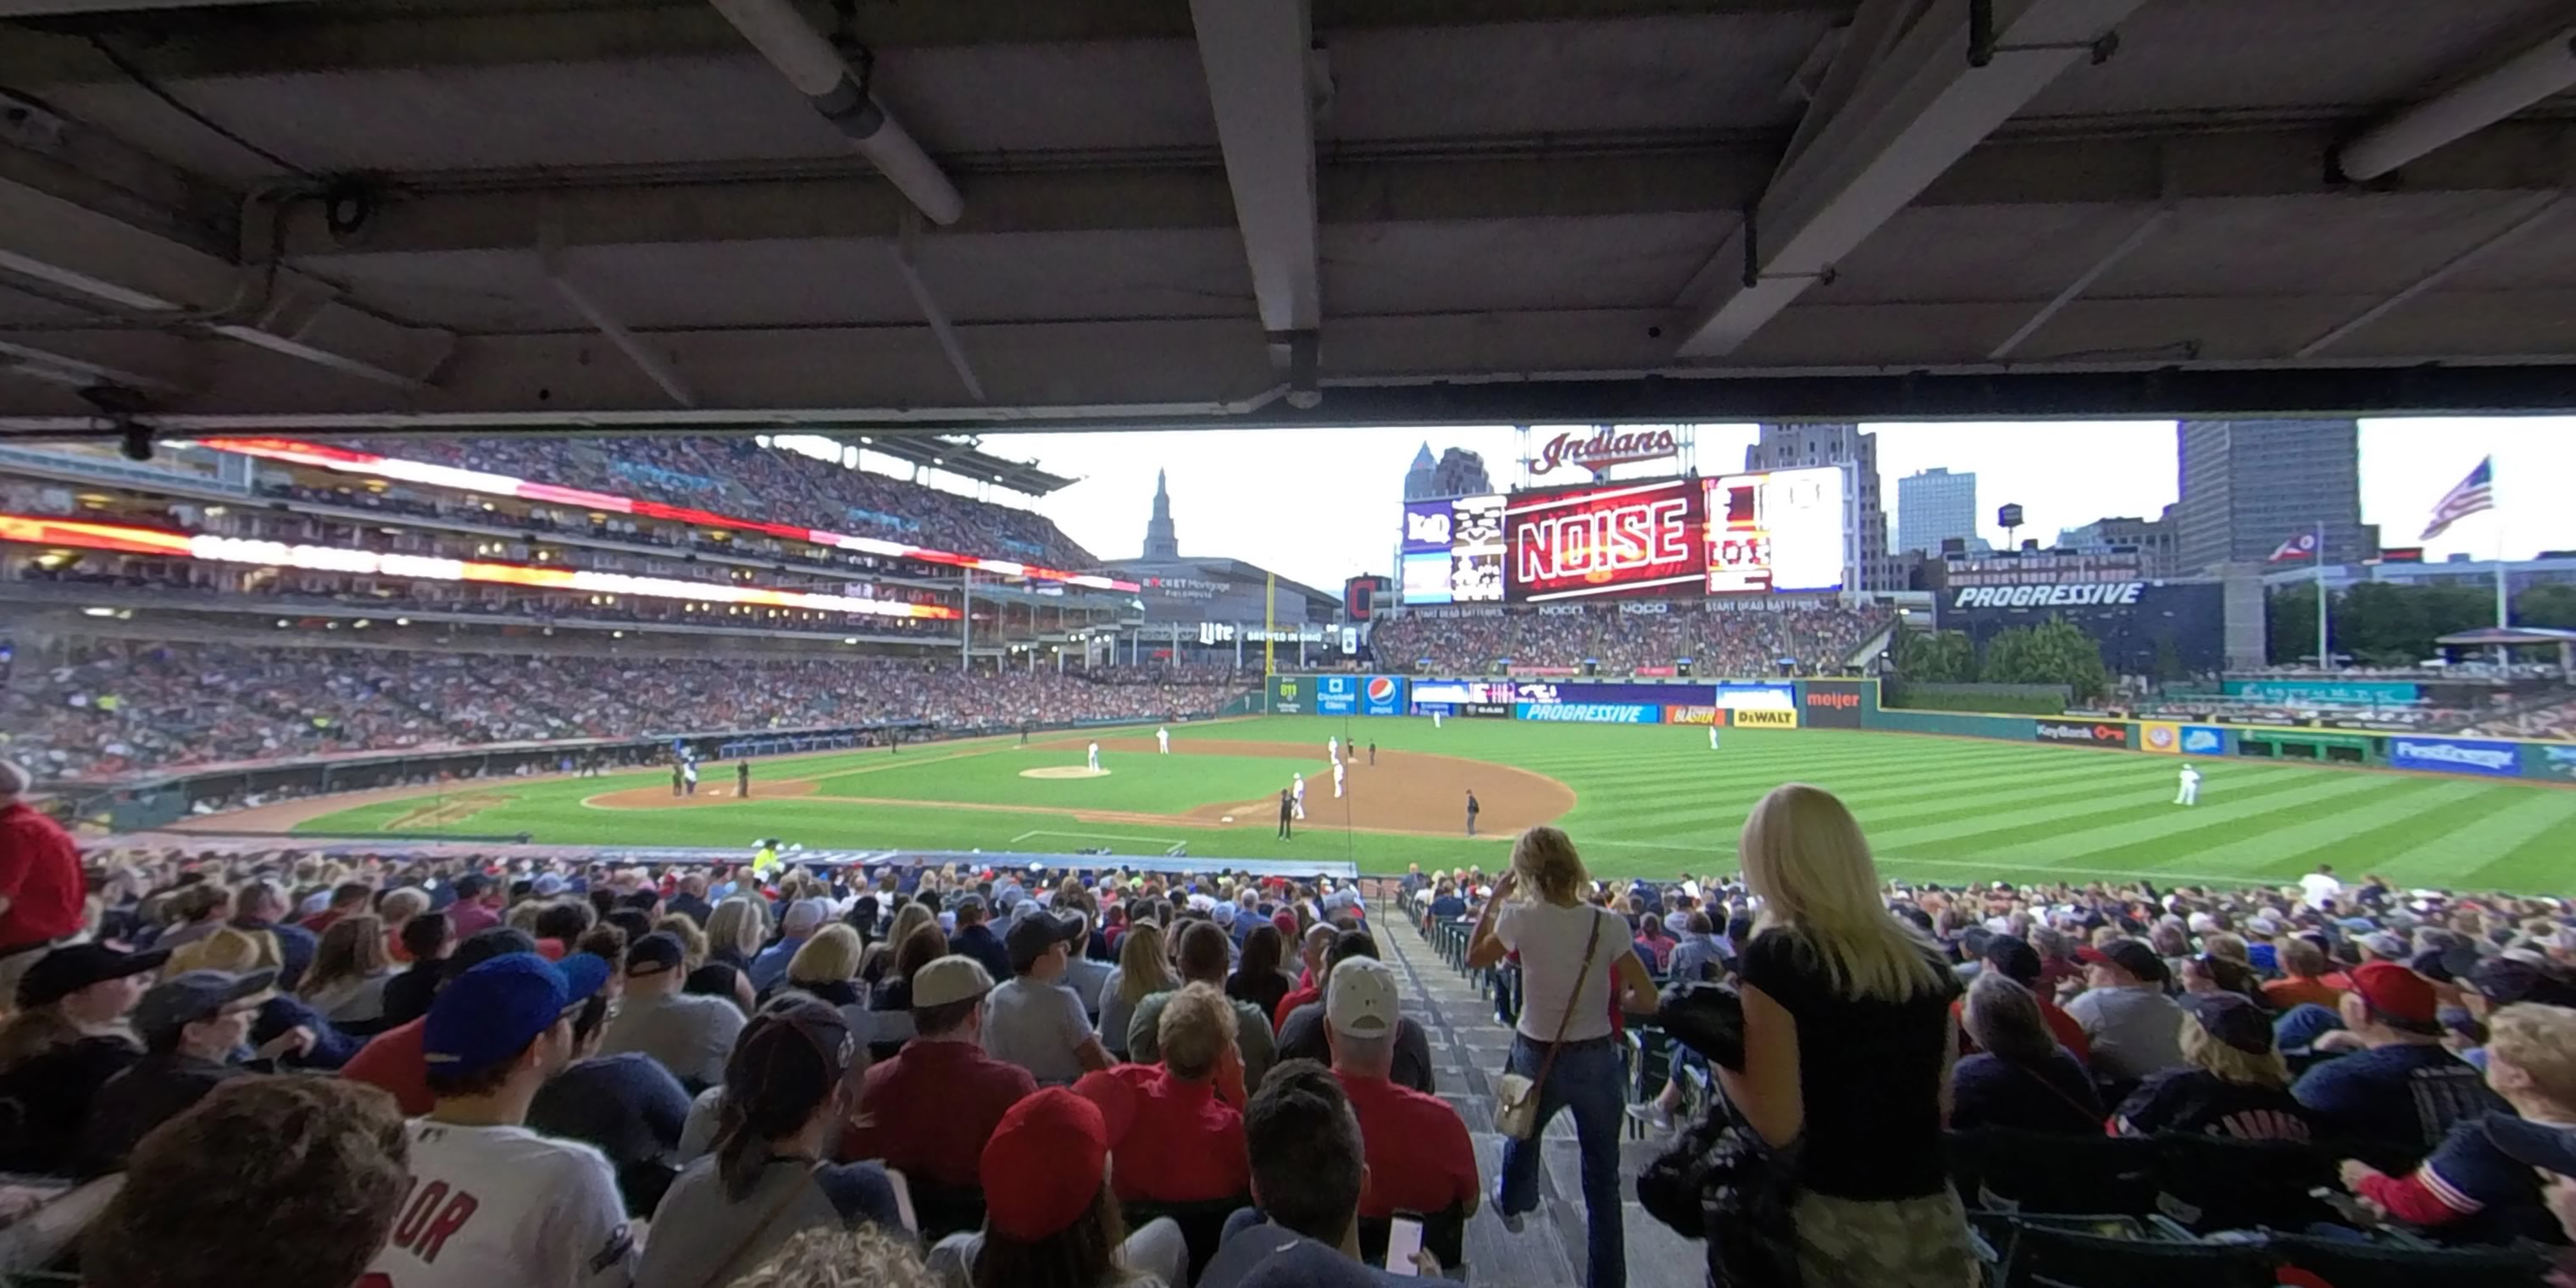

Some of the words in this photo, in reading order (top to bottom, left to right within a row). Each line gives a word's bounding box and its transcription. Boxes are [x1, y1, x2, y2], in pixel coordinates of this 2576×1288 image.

[1529, 430, 1679, 475] Indians
[1518, 497, 1689, 583] NOISE
[1954, 582, 2144, 608] PROGRESSIVE
[1539, 606, 1584, 617] NOCO
[1618, 602, 1667, 614] NOCO
[1199, 622, 1234, 645] Lite
[1287, 633, 1298, 641] IN
[1280, 684, 1296, 697] 811
[1807, 692, 1860, 710] meijer
[1526, 704, 1643, 723] PROGRESSIVE
[2036, 724, 2092, 740] KeyBank
